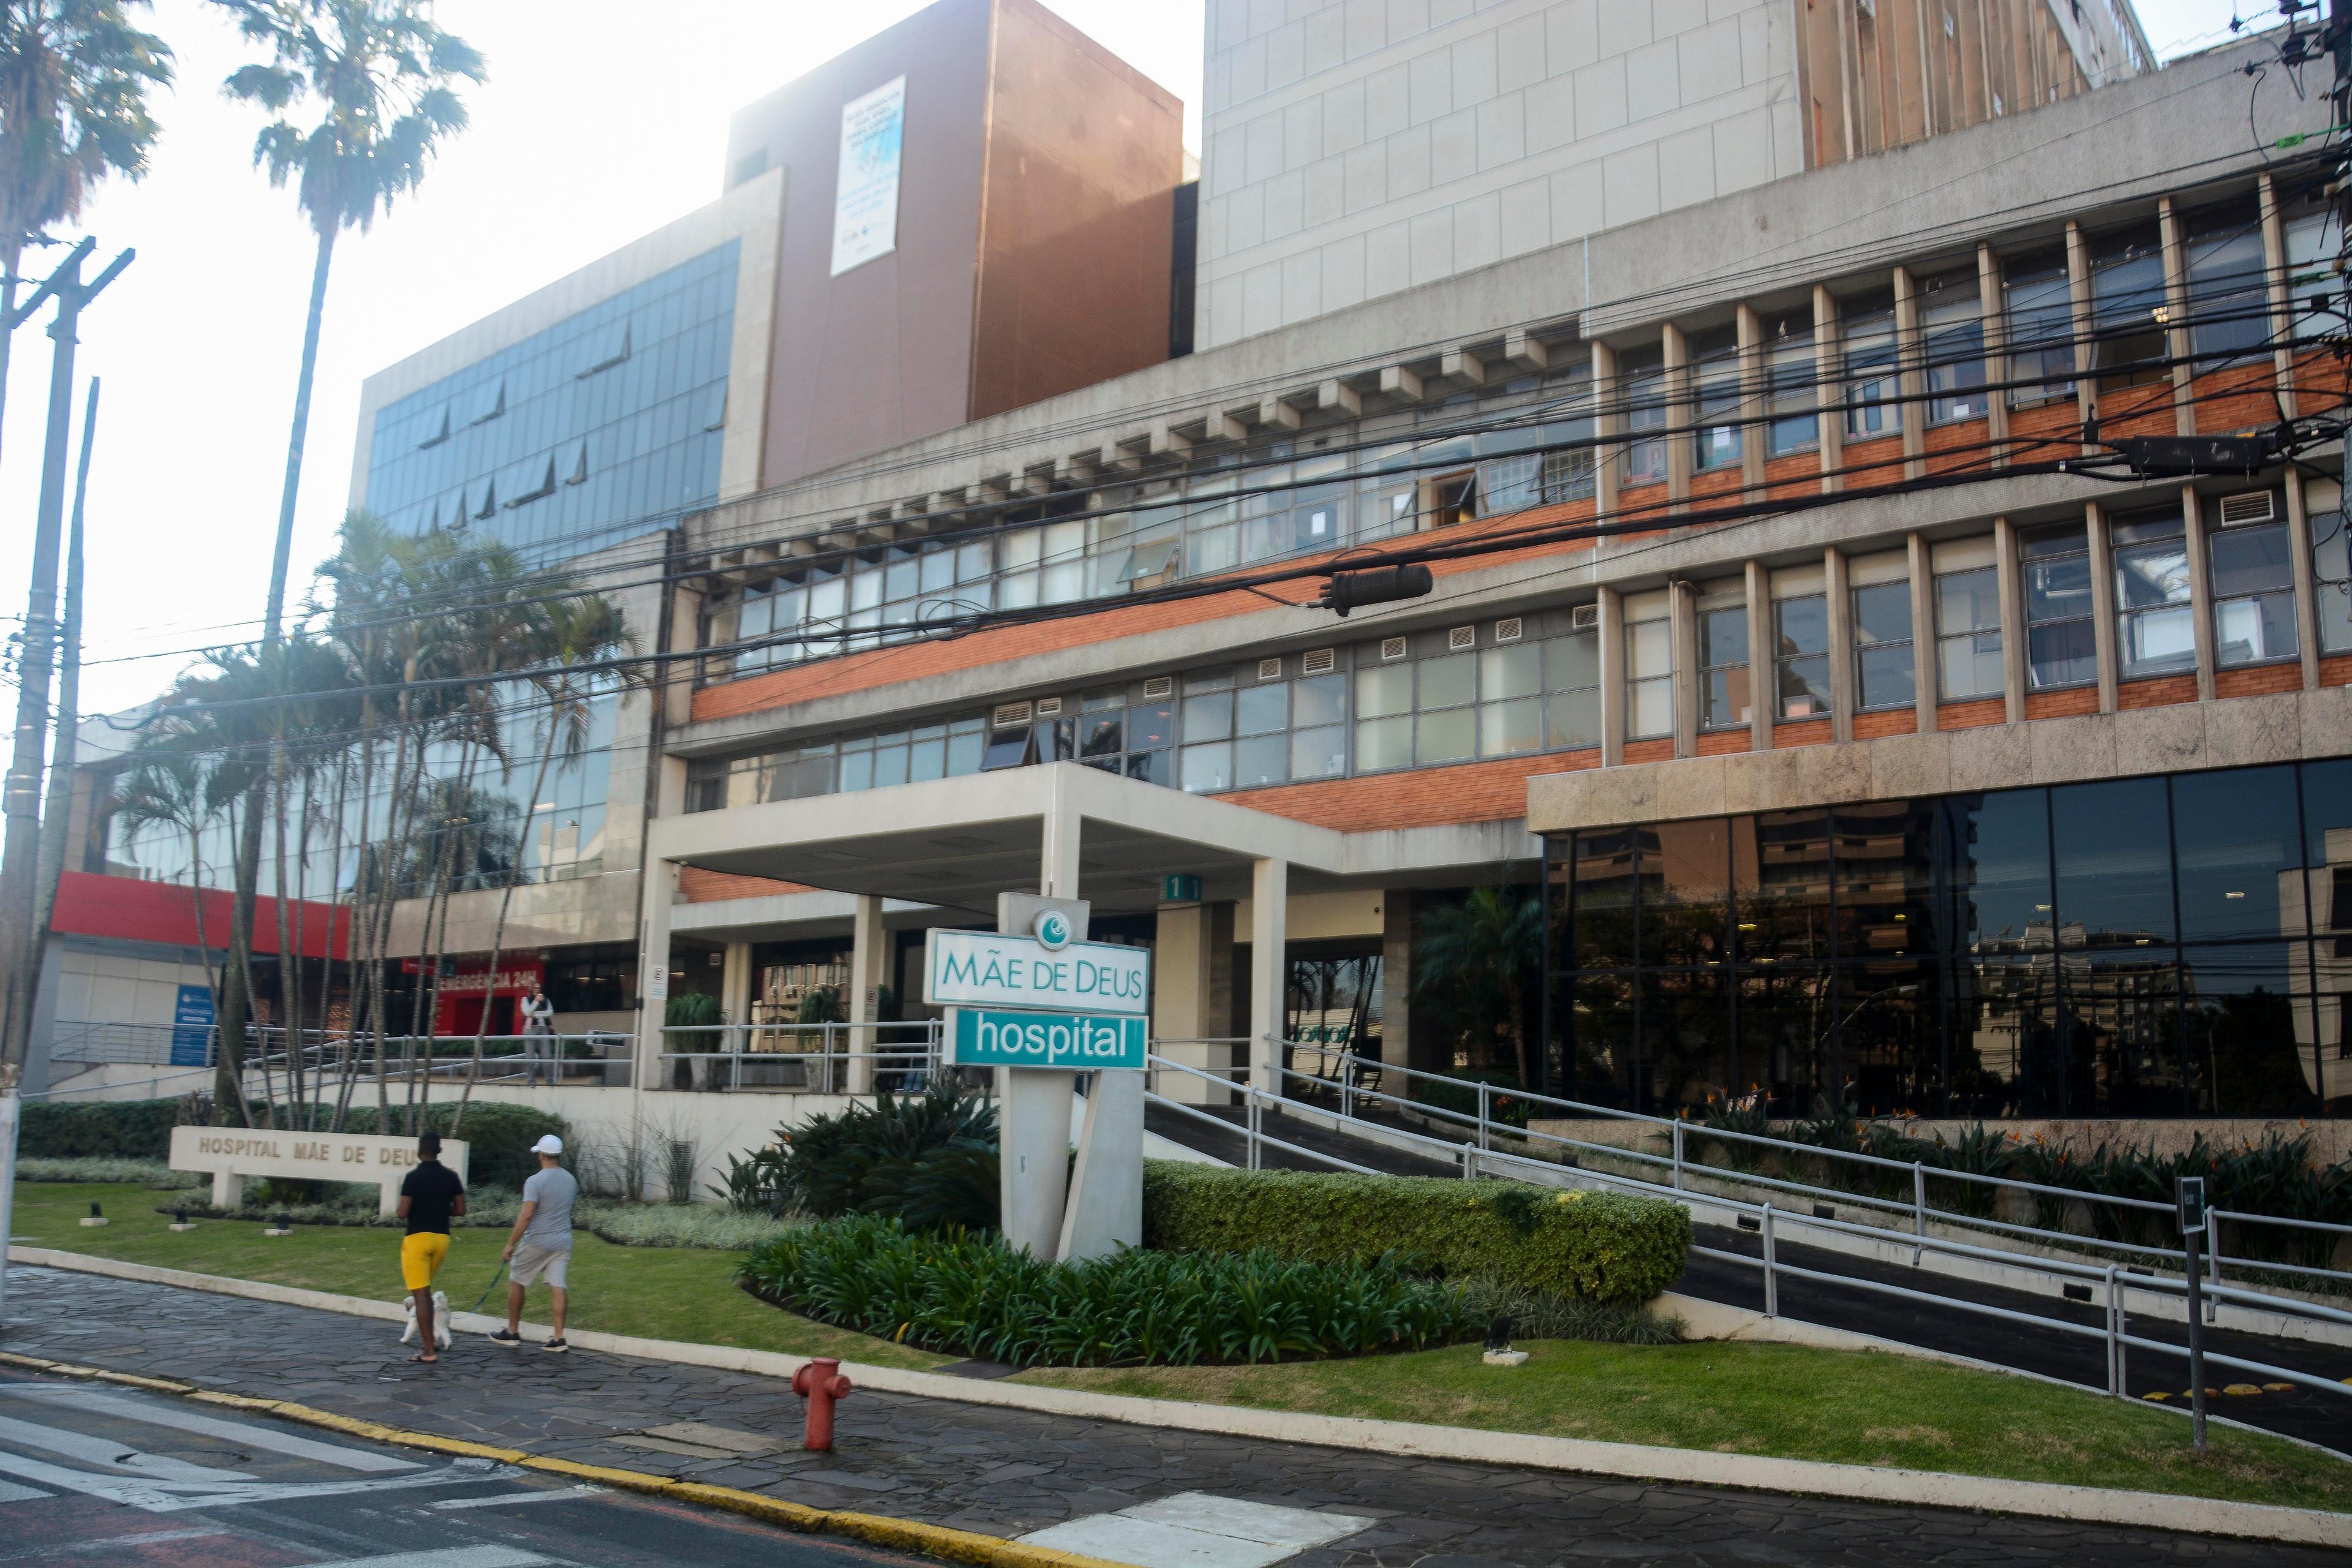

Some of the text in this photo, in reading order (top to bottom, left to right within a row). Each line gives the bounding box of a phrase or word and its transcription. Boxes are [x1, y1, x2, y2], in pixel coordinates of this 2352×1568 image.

[1170, 876, 1179, 897] 1
[942, 948, 1142, 999] MÃE DE DEUS
[976, 1011, 1126, 1063] hospital
[198, 1137, 281, 1158] HOSPITAL
[342, 1145, 366, 1163] DE
[379, 1147, 421, 1166] DEU
